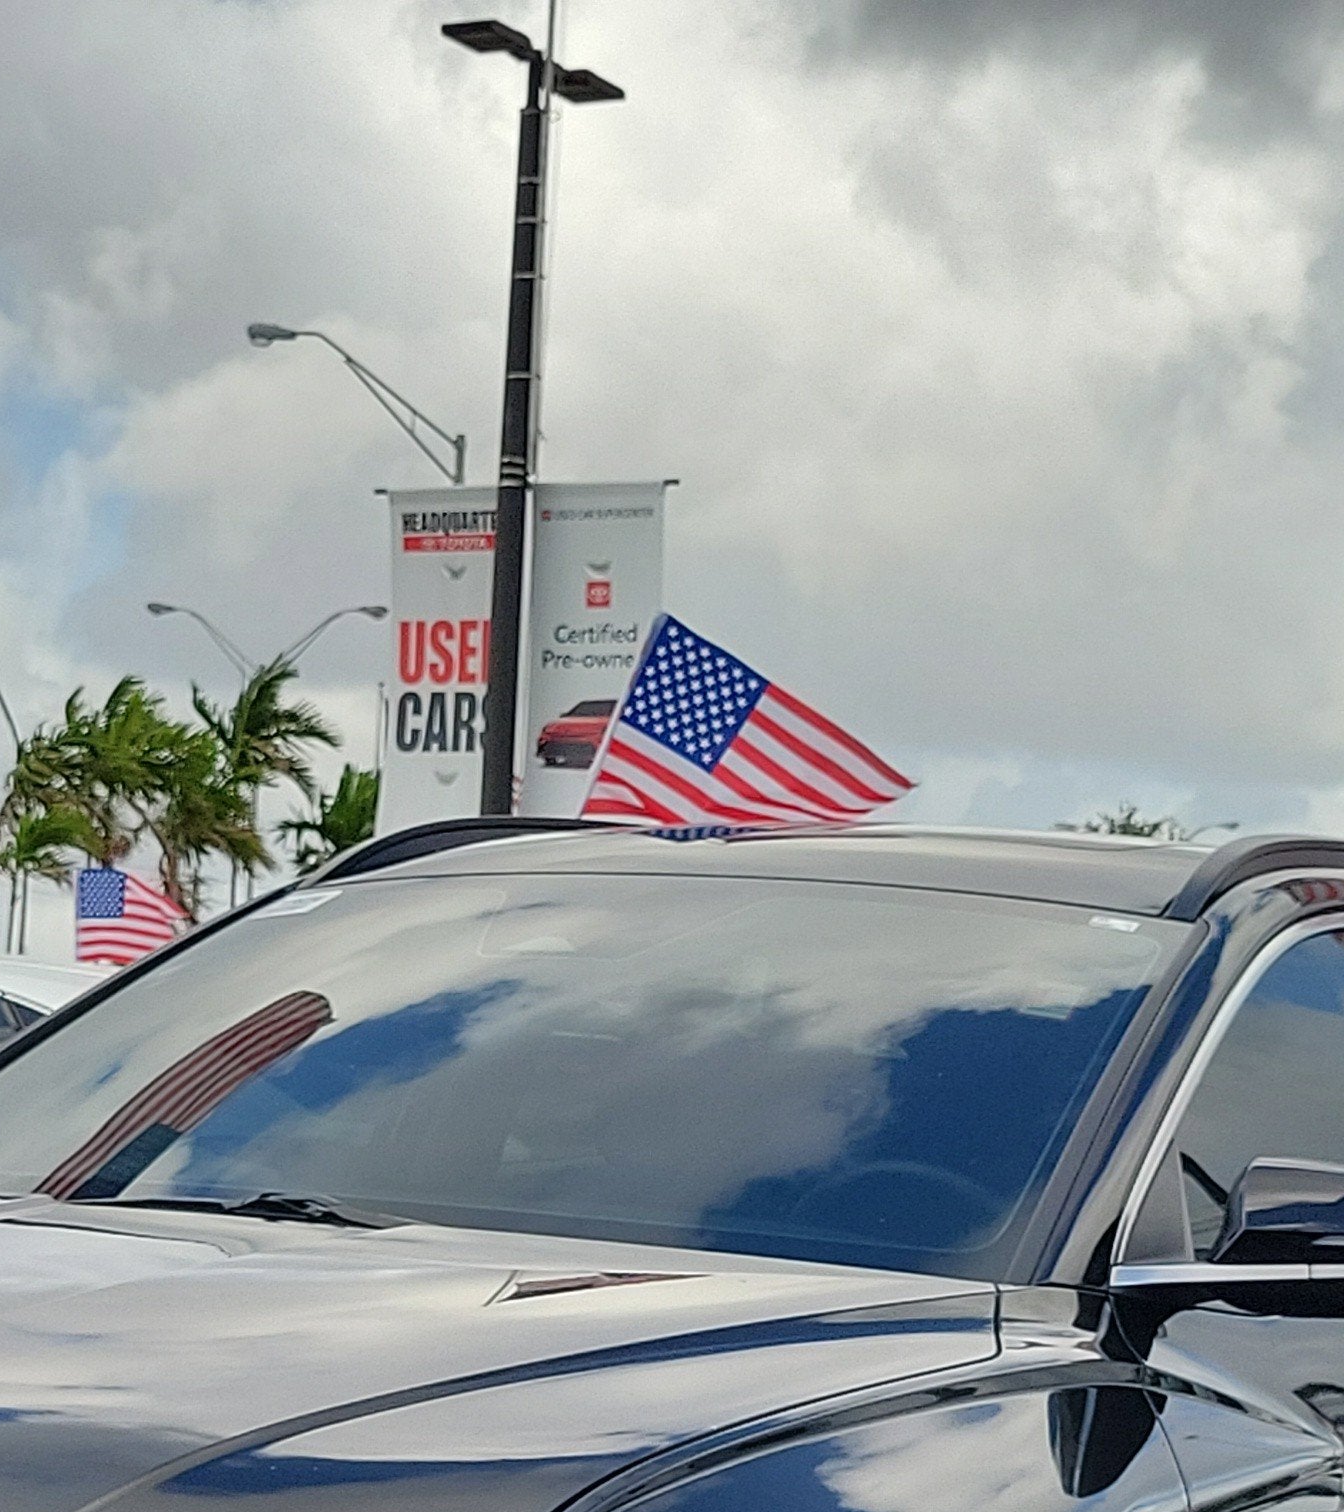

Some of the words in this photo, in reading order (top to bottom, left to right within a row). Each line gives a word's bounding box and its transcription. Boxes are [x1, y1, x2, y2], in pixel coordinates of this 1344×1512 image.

[554, 623, 637, 644] Certified
[542, 651, 633, 669] Pre-owne
[396, 692, 487, 752] CAR
